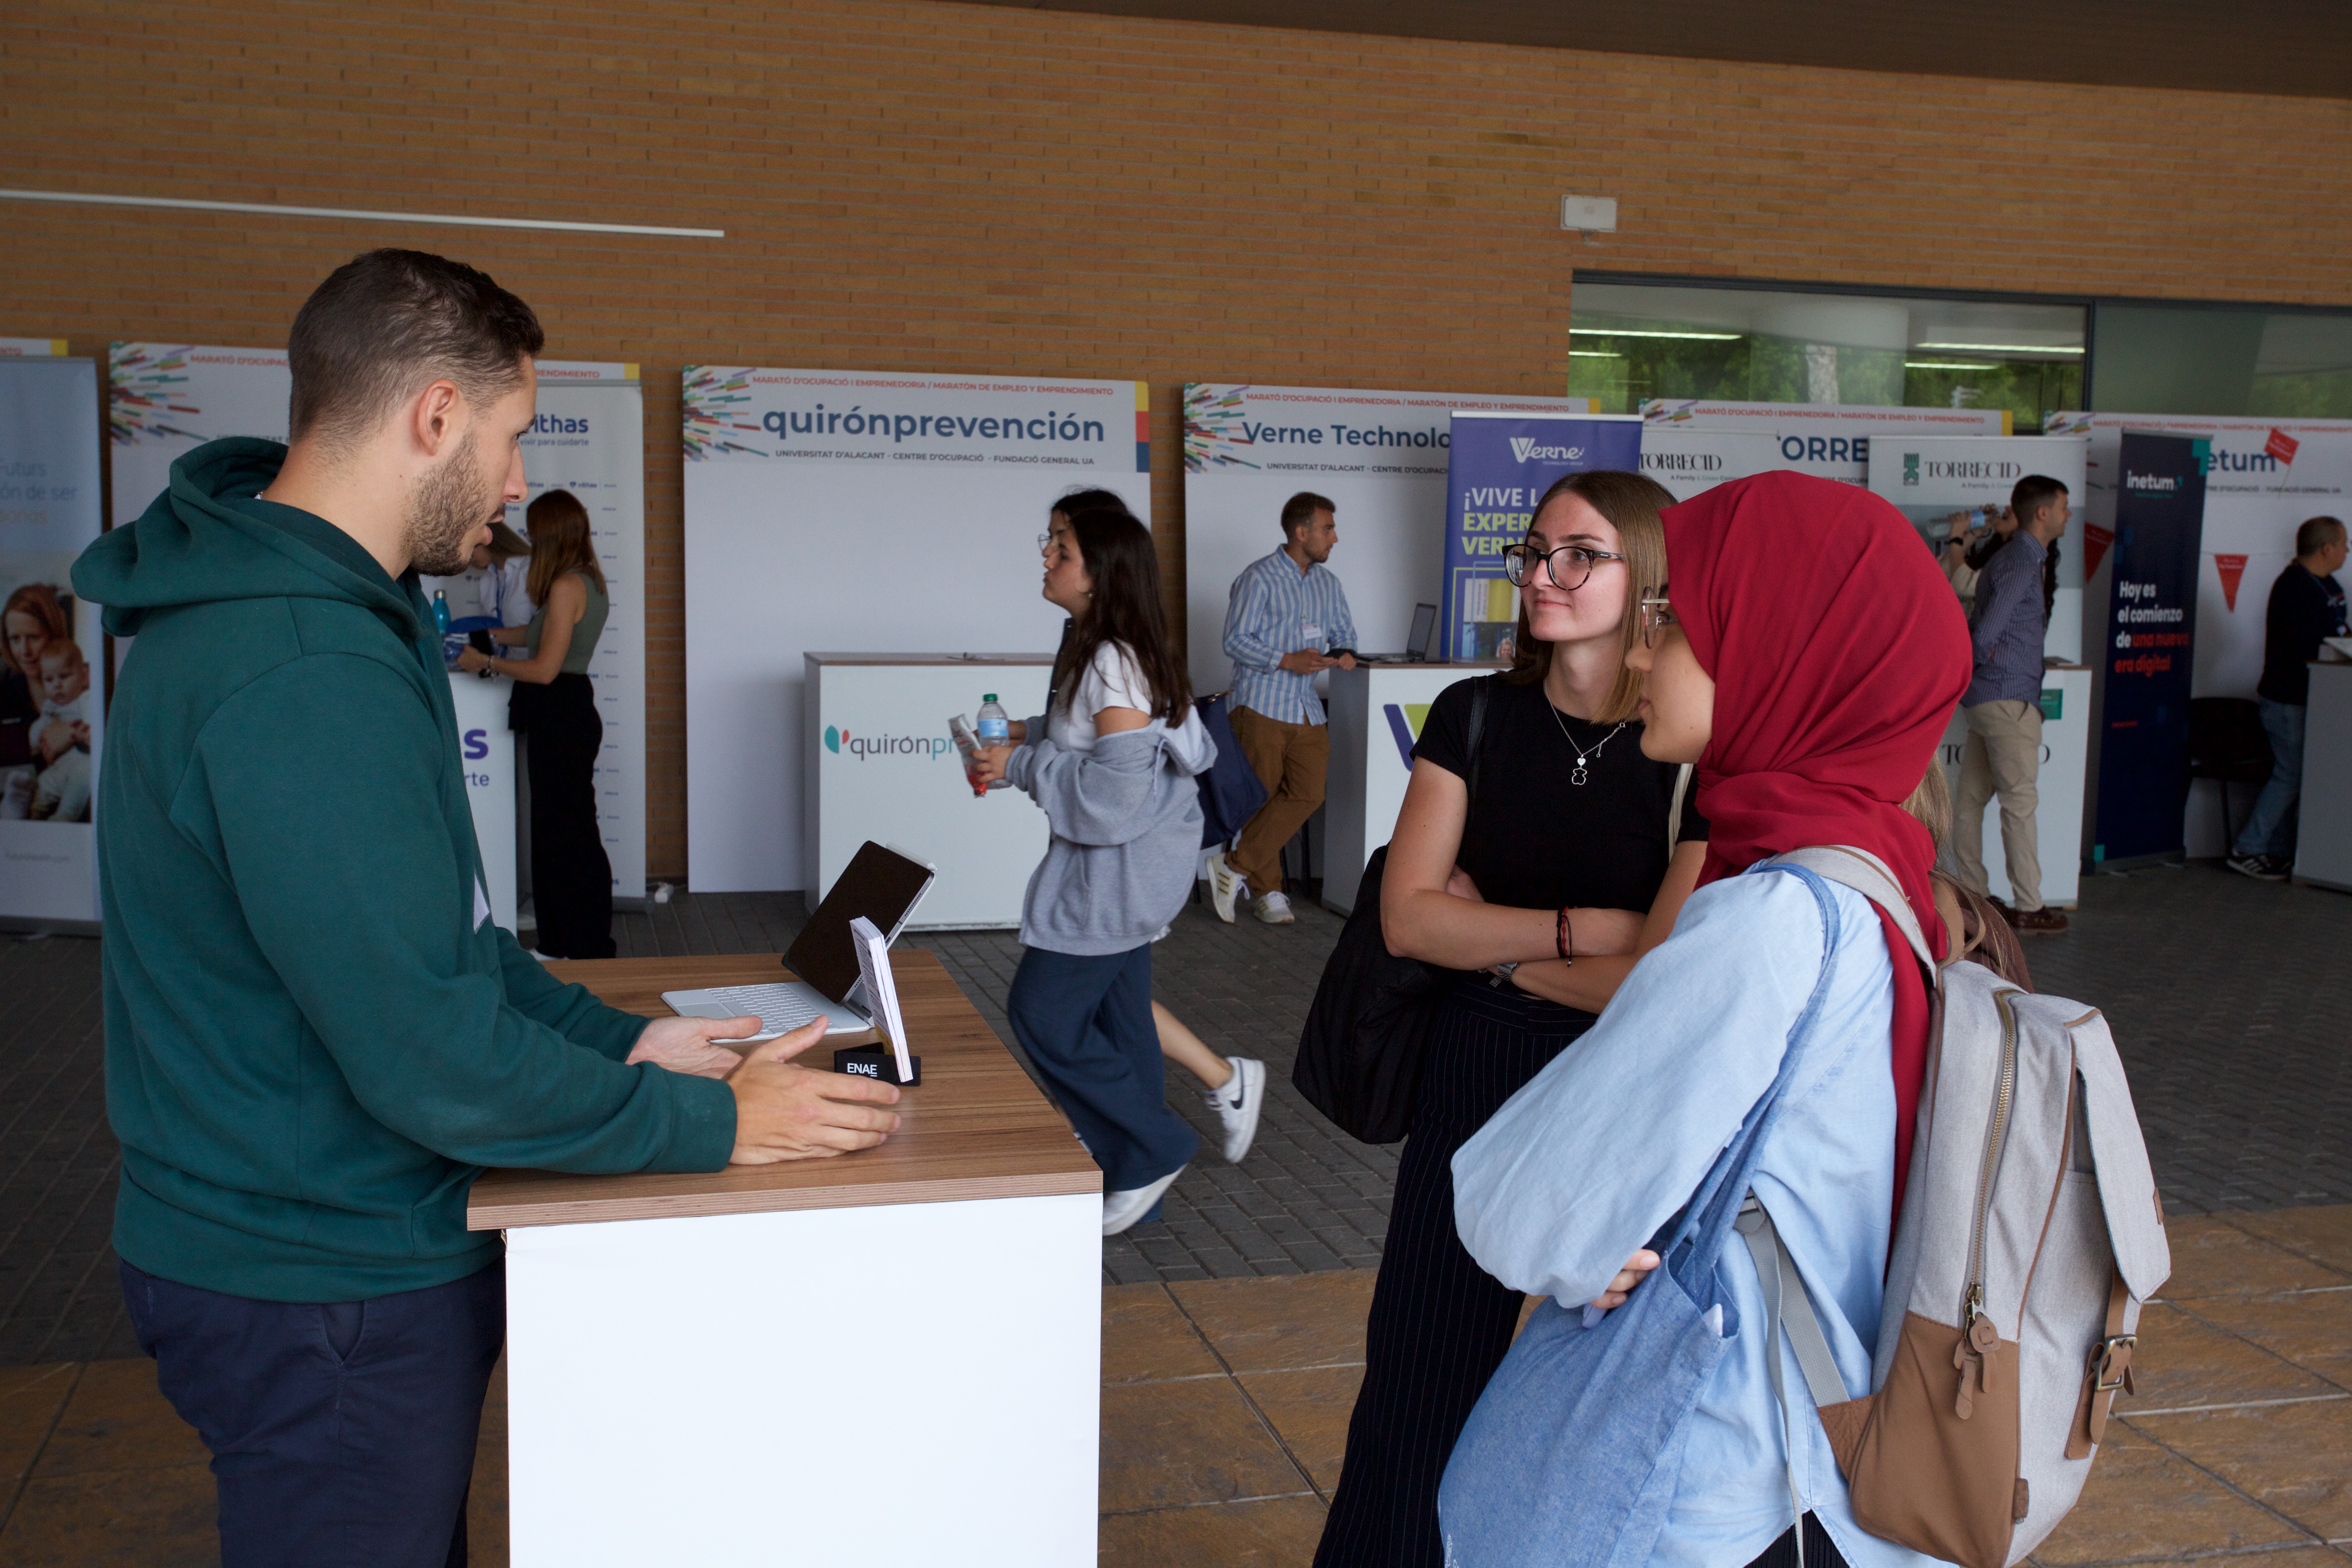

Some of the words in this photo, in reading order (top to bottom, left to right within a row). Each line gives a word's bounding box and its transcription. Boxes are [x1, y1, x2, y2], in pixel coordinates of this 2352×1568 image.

[753, 376, 791, 384] MARATÓ
[793, 377, 849, 386] D'OCUPACIÓ
[856, 379, 926, 388] EMPRENEDORIA
[933, 382, 976, 390] MARATÓN
[1037, 385, 1114, 395] EMPRENDIMIENTO
[1246, 393, 1281, 401] MARATÓ
[1283, 394, 1332, 403] D'OCUPACIÓ
[1339, 396, 1401, 405] EMPRENEDORIA
[1408, 399, 1446, 408] MARATÓN
[1500, 403, 1569, 412] EMPRENDIMIENTO
[533, 413, 589, 434] ithas
[763, 403, 1104, 443] quirónprevención
[1728, 408, 1773, 417] D'OCUPACIÓ
[1779, 410, 1835, 419] EMPRENEDORIA
[1841, 412, 1876, 420] MARATÓN
[1924, 414, 1985, 423] EMPRENDIMIENTO
[537, 439, 556, 447] para
[557, 438, 590, 446] cuidarte
[1242, 422, 1323, 444] Verne
[1330, 425, 1450, 448] Technolo
[776, 450, 833, 459] UNIVERSITAT
[836, 451, 885, 459] D'ALACANT
[930, 453, 984, 461] D'OCUPACIÓ
[993, 455, 1038, 463] FUNDACIÓ
[1510, 437, 1581, 463] Verne
[1777, 435, 1869, 462] ORRE
[1924, 461, 2022, 479] TORRECID
[2208, 449, 2276, 472] etum
[1405, 467, 1448, 475] D'OCUPACI
[1464, 488, 1522, 510] ¡VIVE
[1530, 488, 1538, 506] L
[1463, 513, 1532, 531] EXPER
[2119, 580, 2141, 604] Hoy
[2143, 584, 2157, 598] es
[2118, 605, 2129, 623] el
[2130, 604, 2183, 623] comienzo
[2116, 631, 2132, 648] de
[2132, 634, 2154, 648] una
[2156, 633, 2189, 647] nueva
[2115, 659, 2134, 673] era
[2135, 654, 2171, 677] digital
[850, 734, 953, 761] quirónpr
[847, 1063, 878, 1075] ENAE
